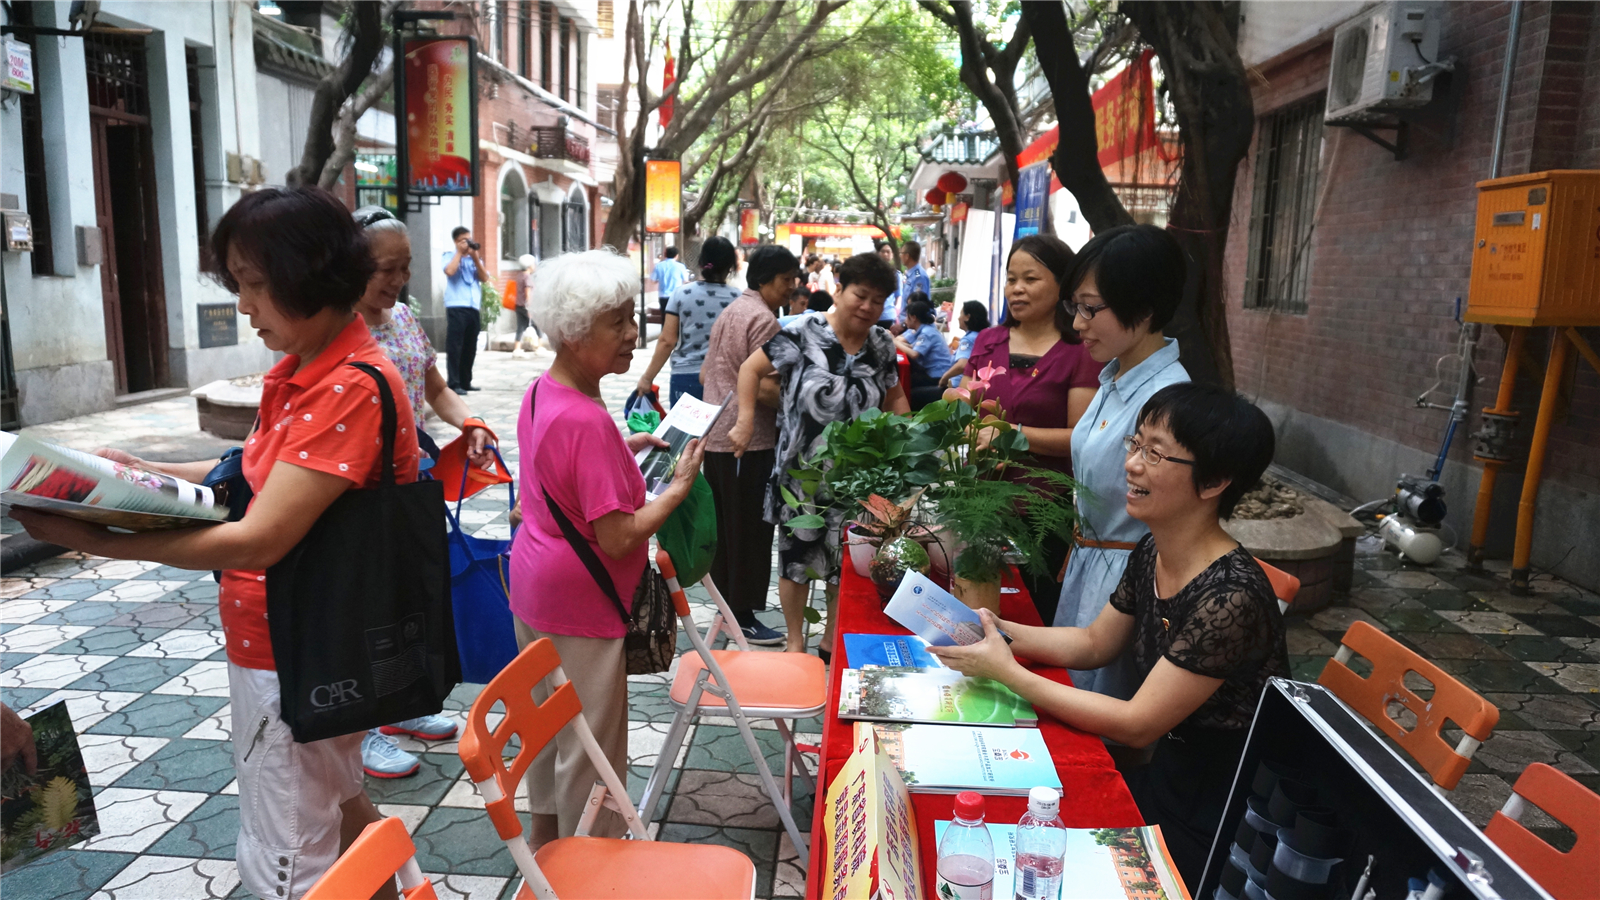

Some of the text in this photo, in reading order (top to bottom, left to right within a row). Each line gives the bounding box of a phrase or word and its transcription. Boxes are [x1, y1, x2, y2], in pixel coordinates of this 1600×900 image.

[445, 102, 454, 126] 务实
[309, 679, 363, 707] CAR
[851, 768, 867, 878] 广东省农科院
